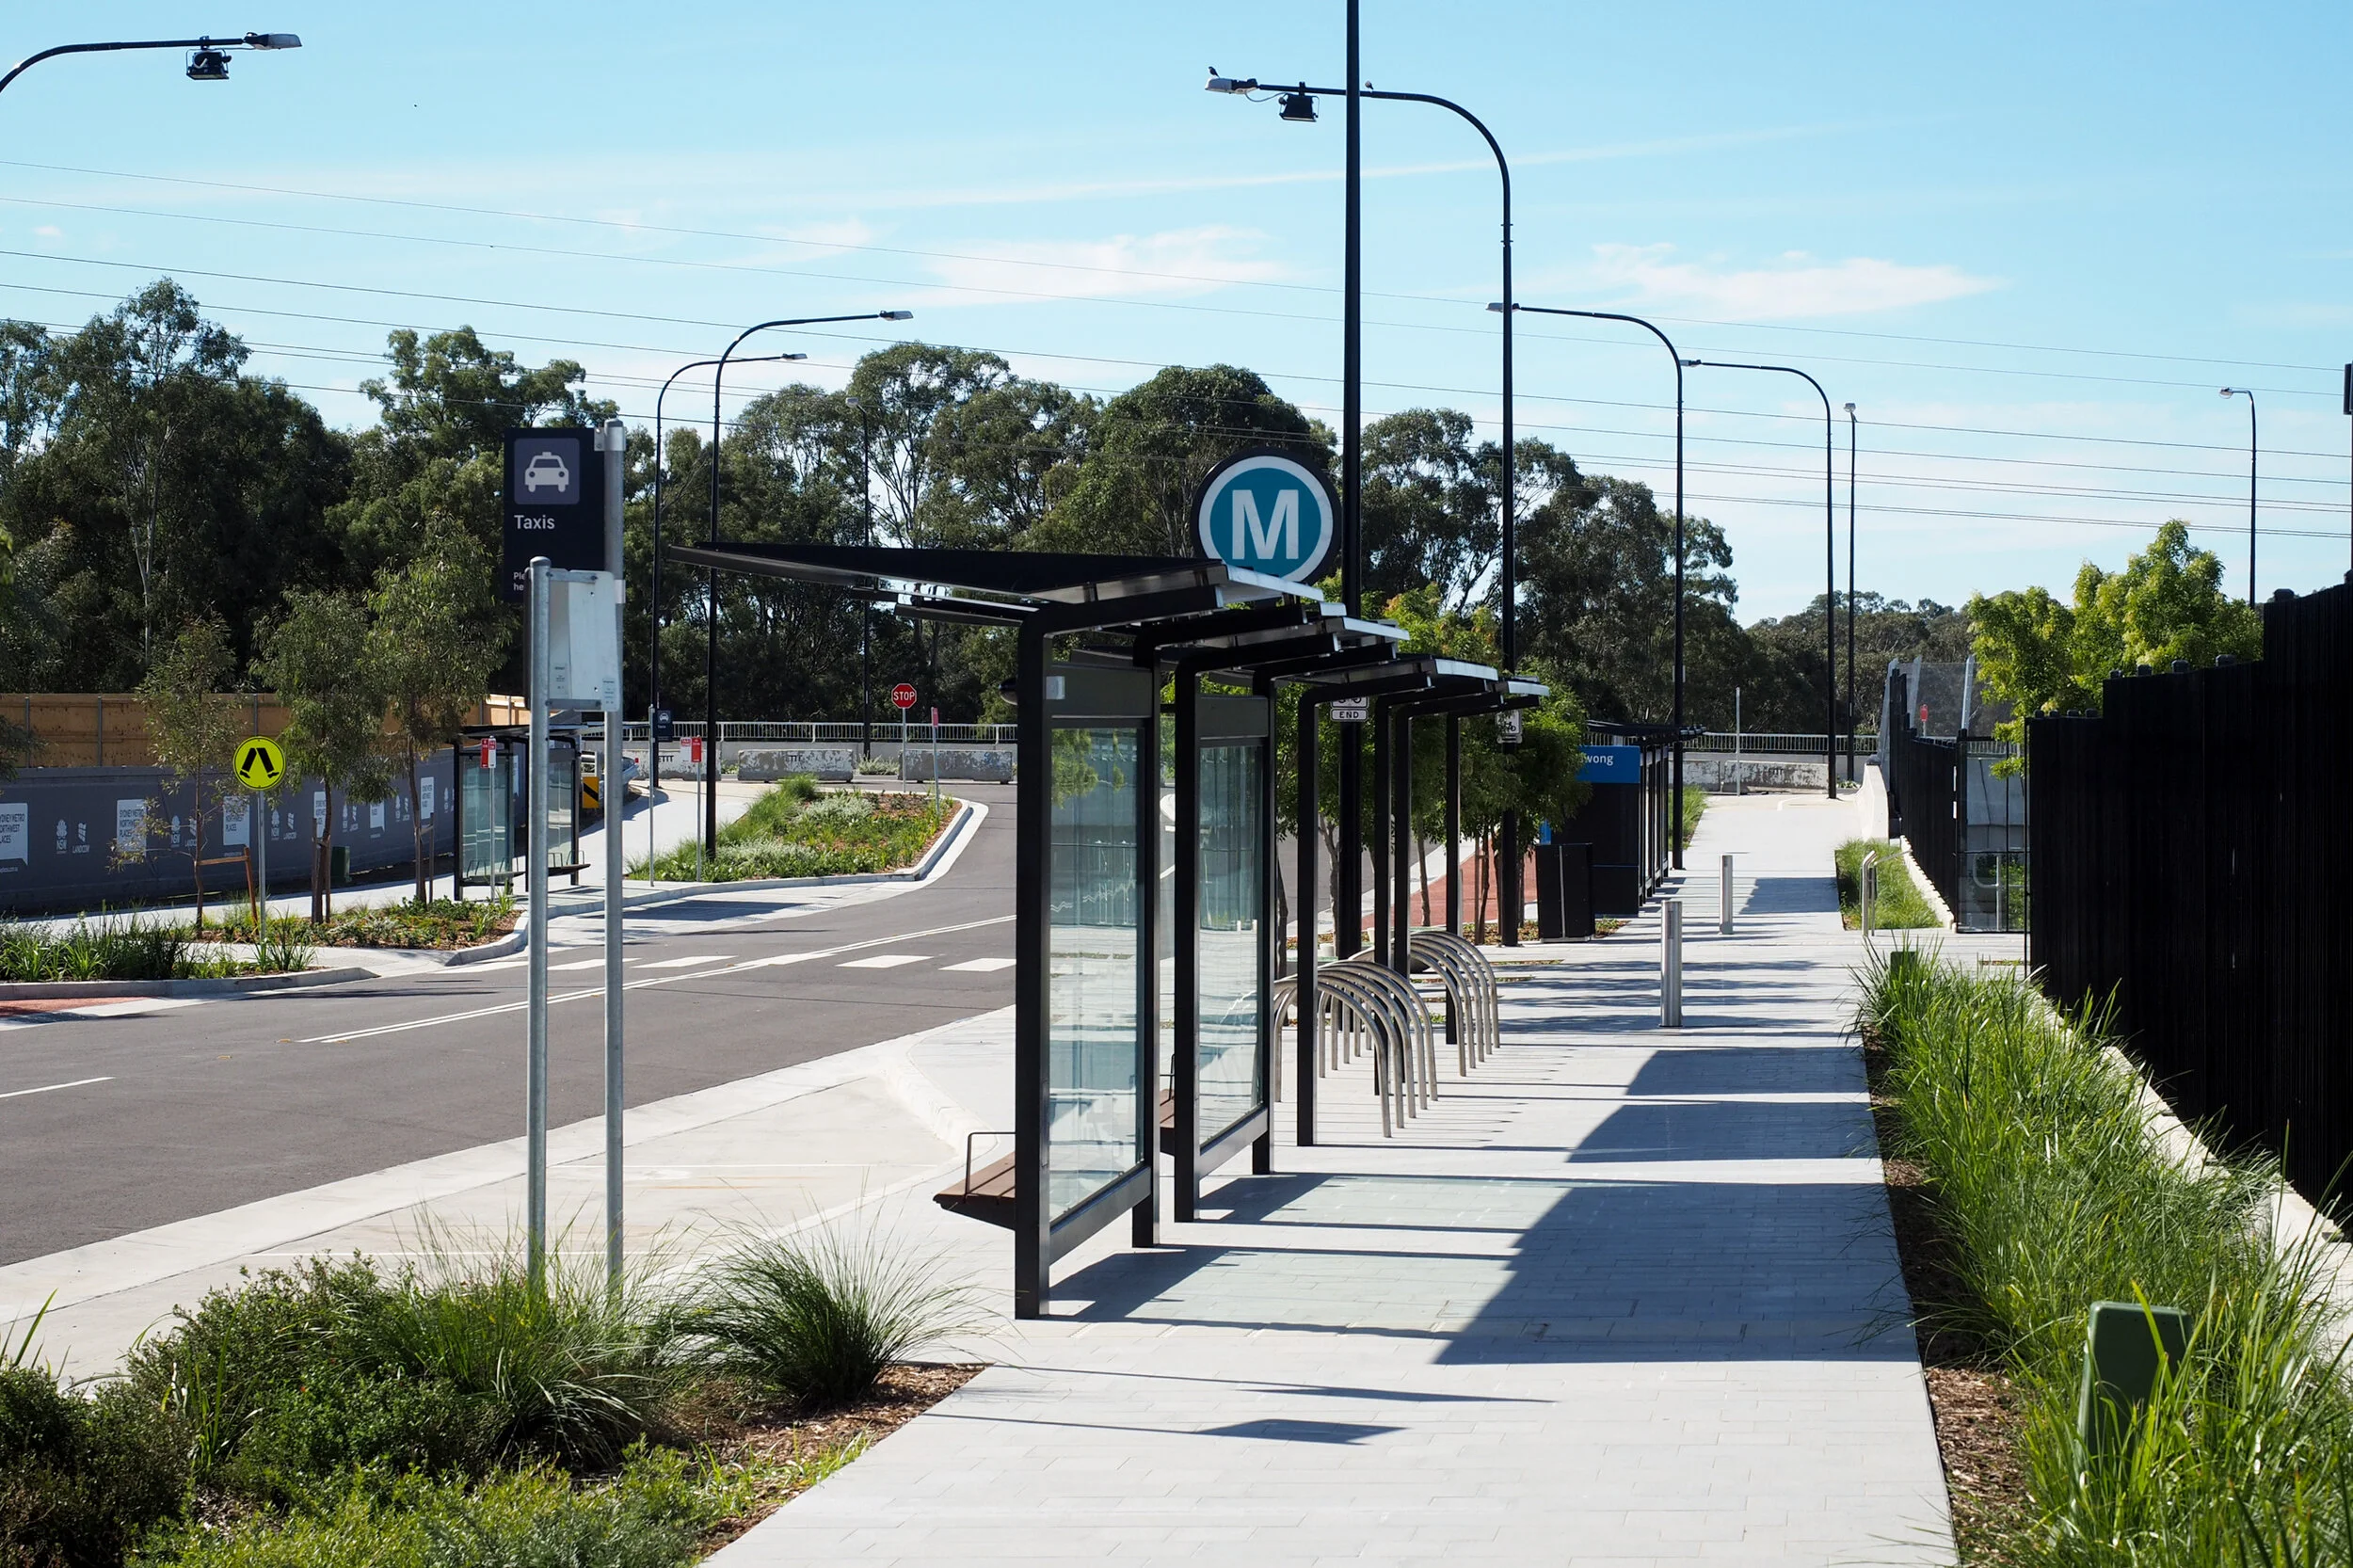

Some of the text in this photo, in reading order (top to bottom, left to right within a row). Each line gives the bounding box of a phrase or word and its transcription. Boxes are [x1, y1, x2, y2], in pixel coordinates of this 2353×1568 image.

[513, 514, 555, 530] Taxis
[1232, 488, 1299, 560] M
[893, 691, 915, 701] STOP
[1339, 711, 1359, 719] END
[1581, 755, 1614, 766] wong
